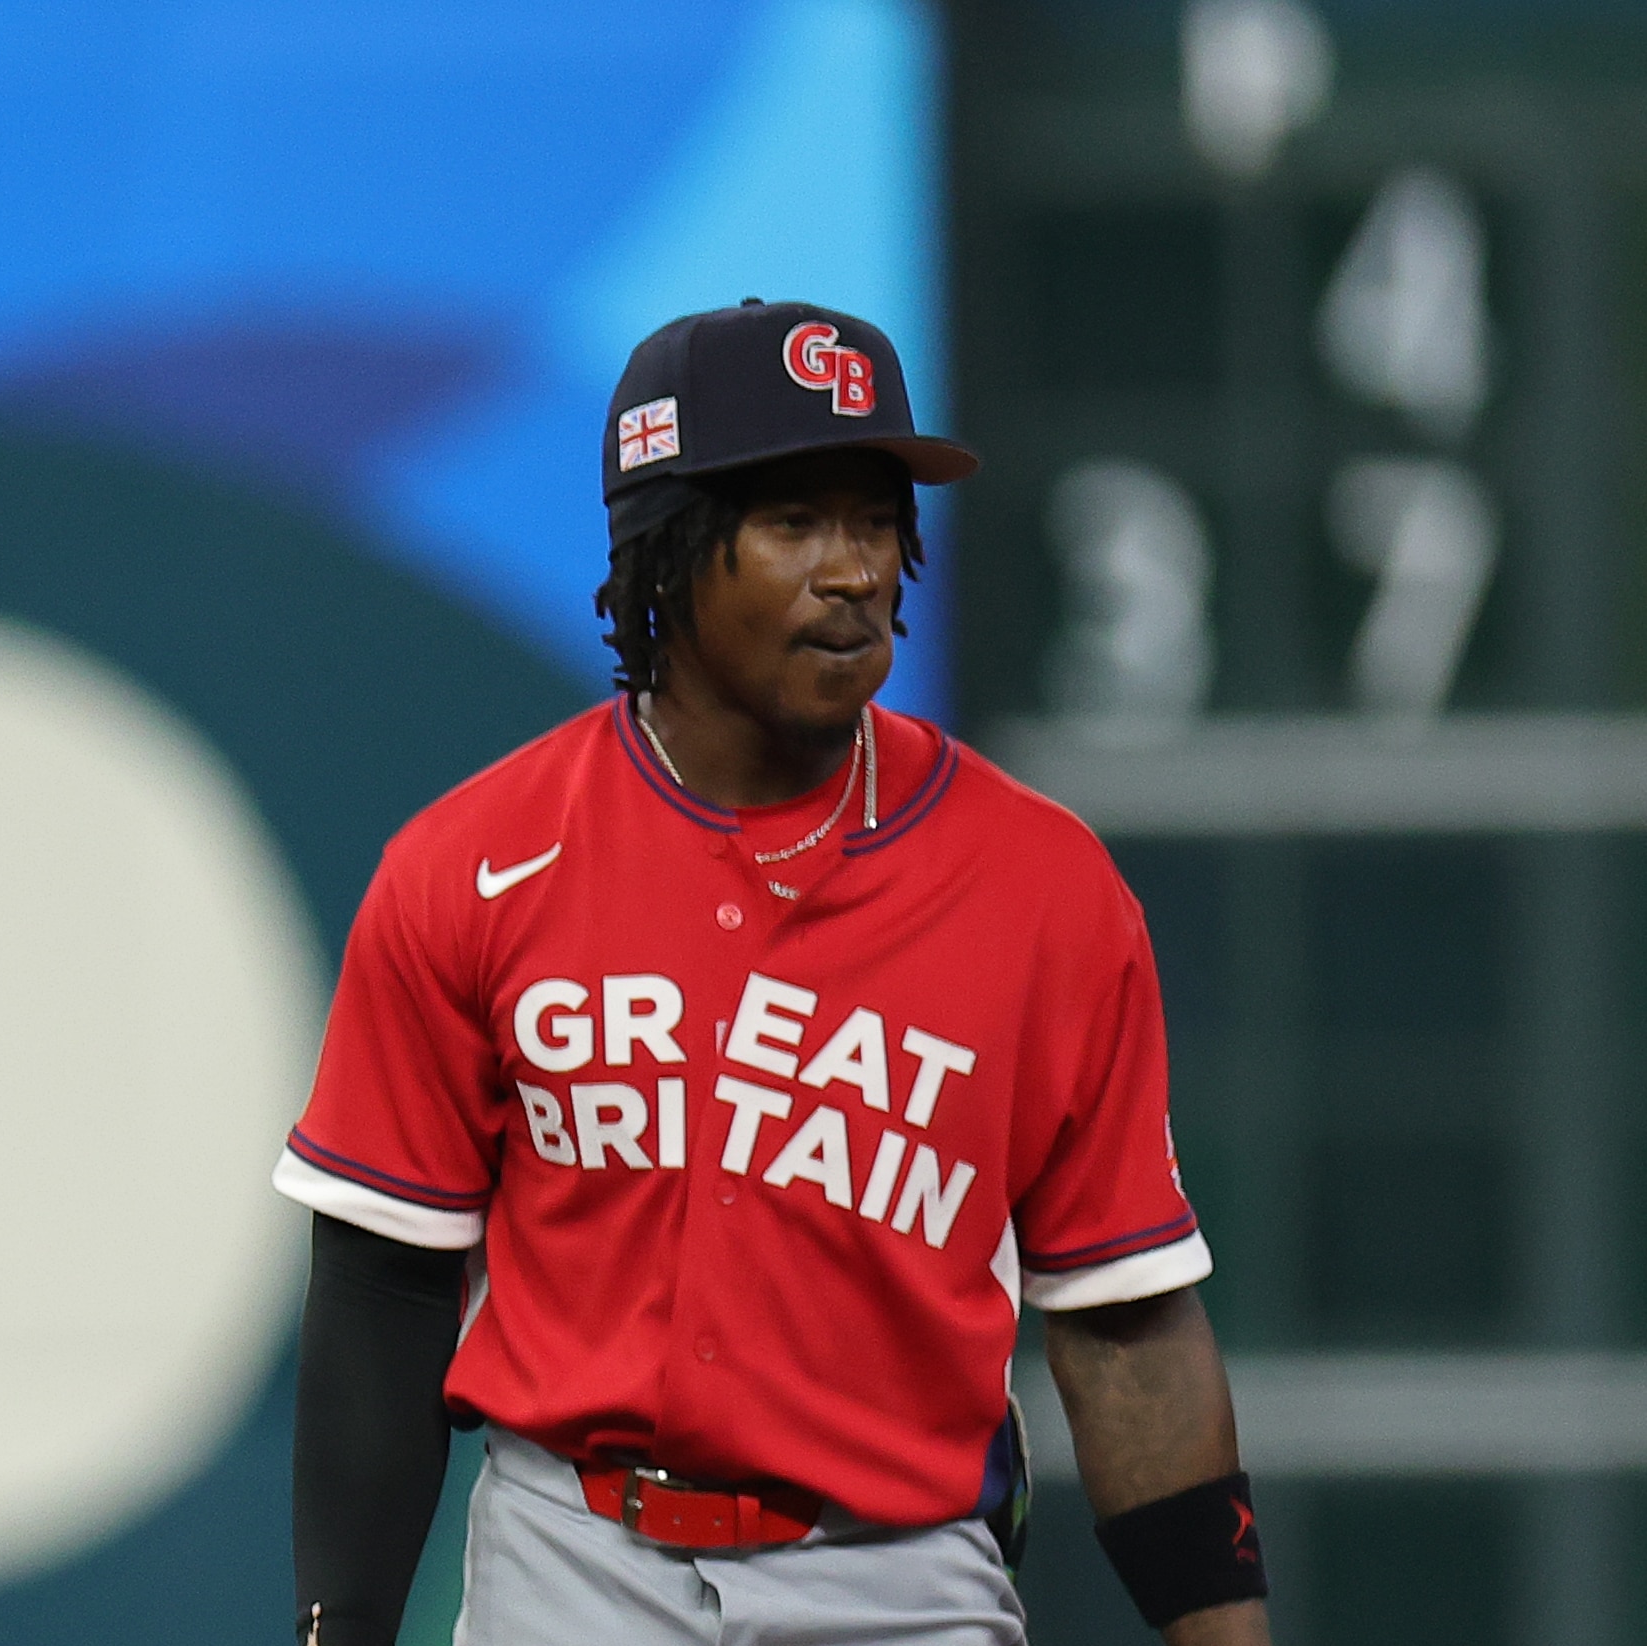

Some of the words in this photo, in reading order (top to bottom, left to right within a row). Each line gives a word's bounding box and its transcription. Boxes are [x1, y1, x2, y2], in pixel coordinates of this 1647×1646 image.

[783, 321, 875, 417] GB
[1309, 165, 1492, 442] 4
[513, 971, 977, 1129] GREAT
[515, 1074, 977, 1250] BRITAIN
